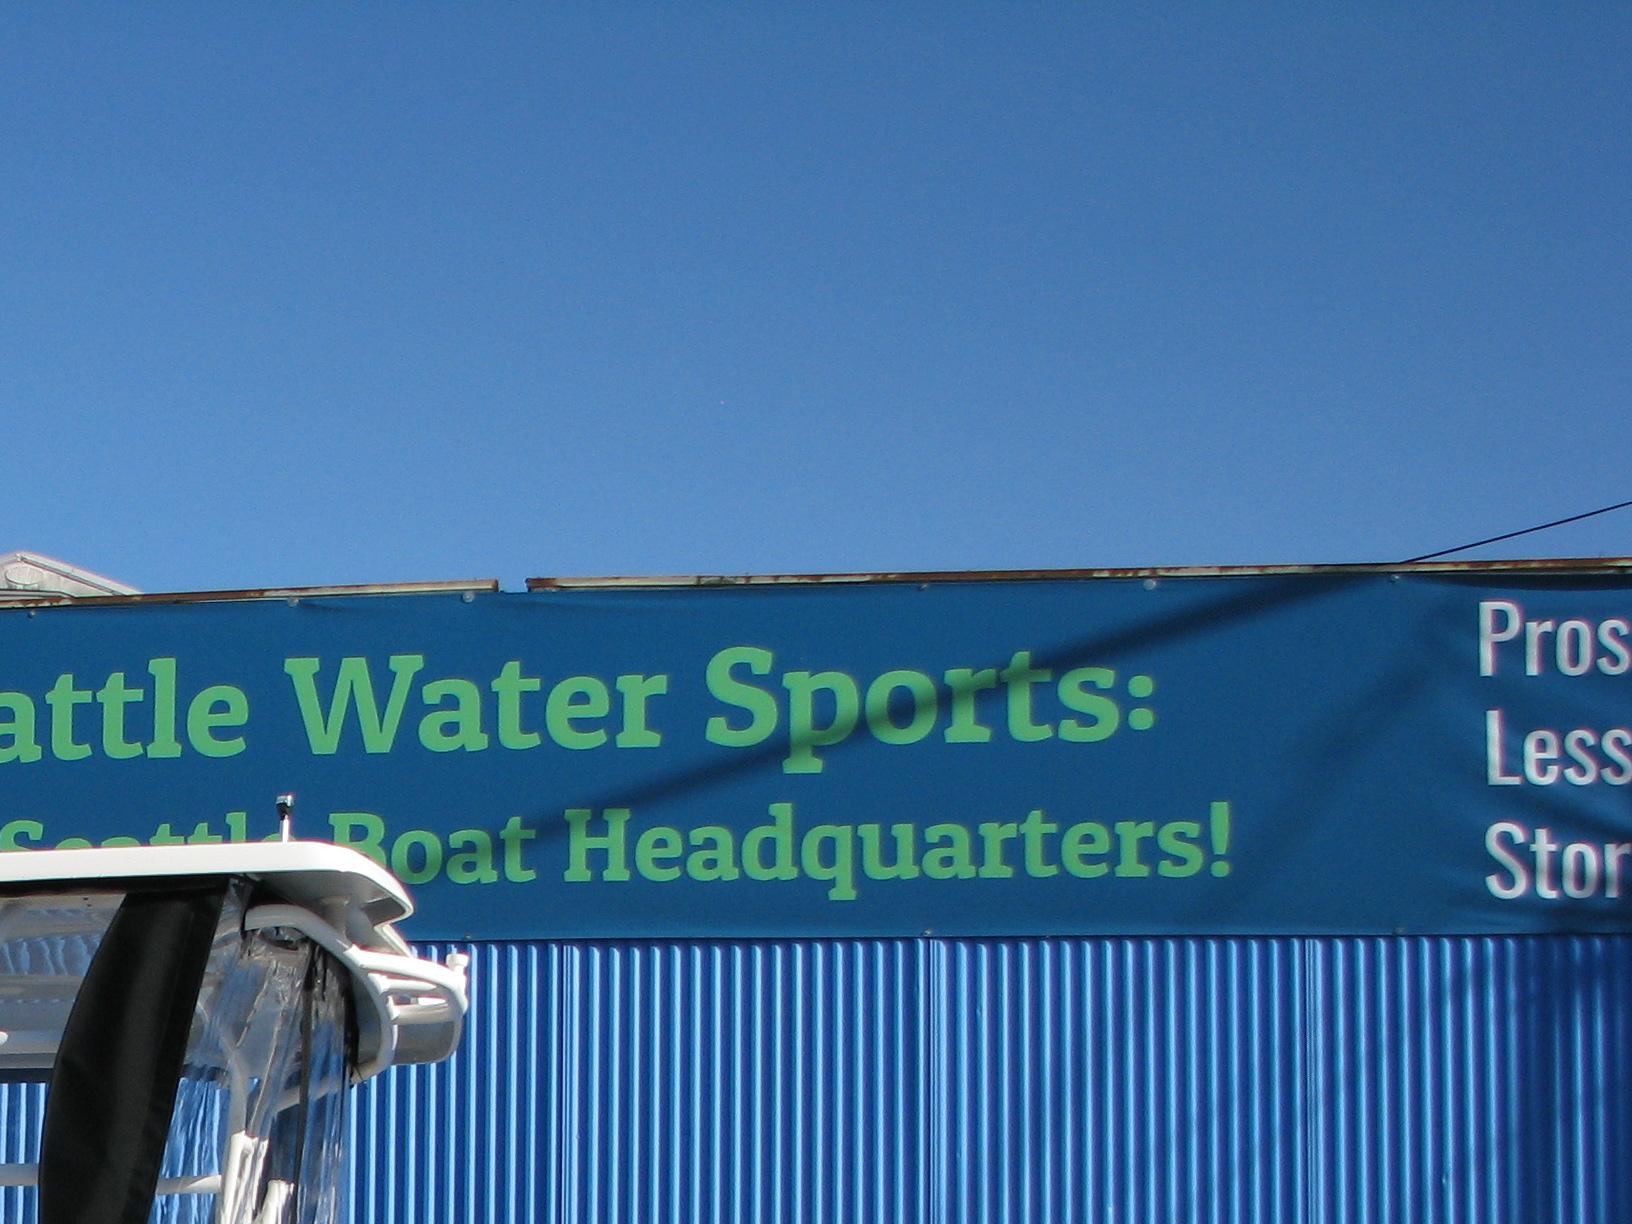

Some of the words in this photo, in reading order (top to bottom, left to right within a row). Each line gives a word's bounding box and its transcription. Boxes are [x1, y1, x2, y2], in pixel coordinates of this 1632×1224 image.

[1478, 600, 1632, 678] Pros
[284, 654, 667, 754] Water
[705, 646, 1157, 774] Sports:
[1485, 709, 1632, 786] Less
[329, 812, 537, 885] Boat
[563, 801, 1231, 901] Headquarters!
